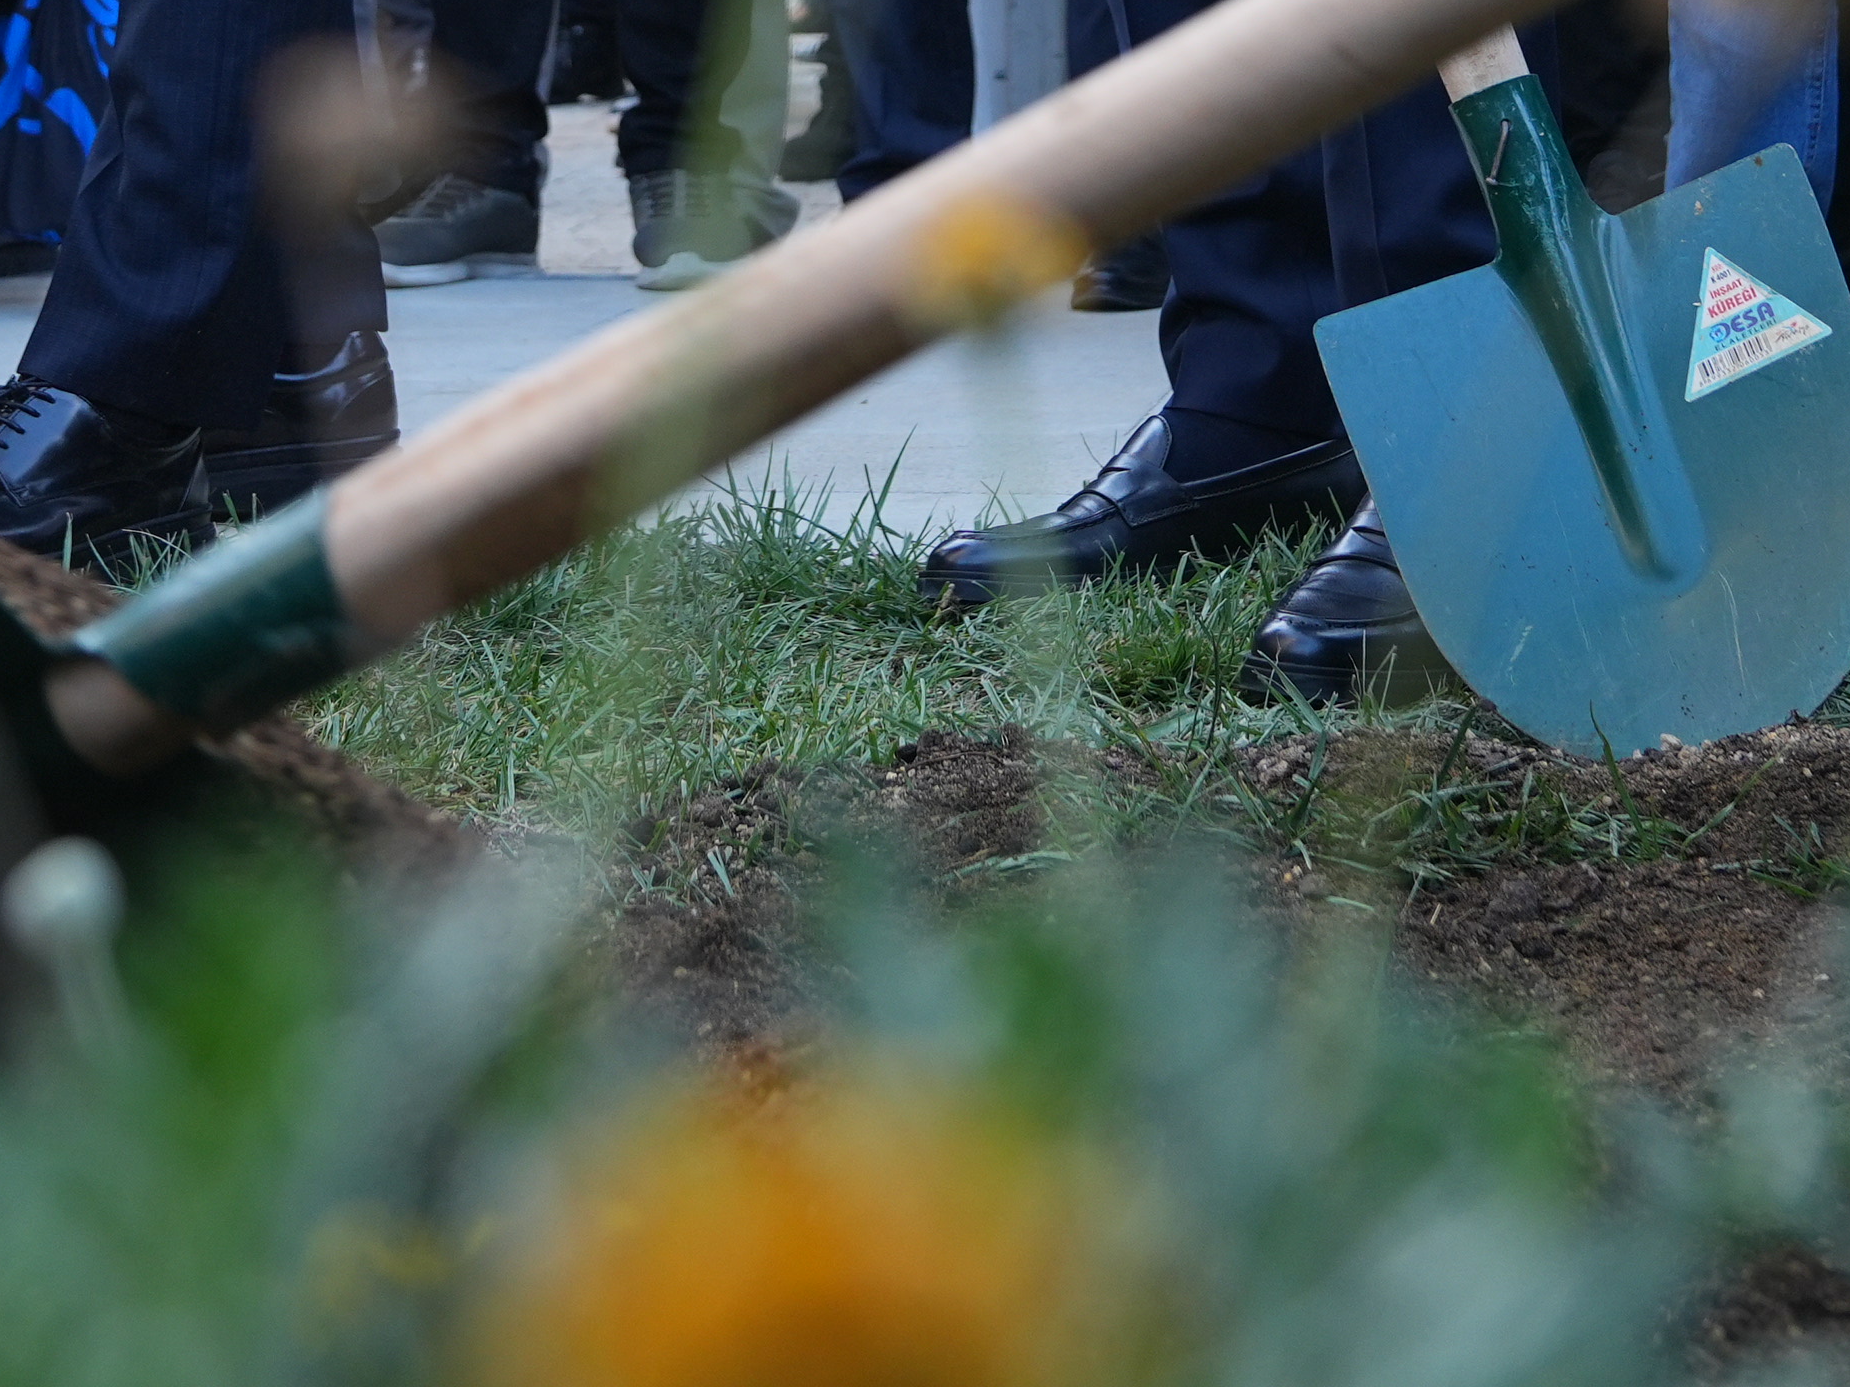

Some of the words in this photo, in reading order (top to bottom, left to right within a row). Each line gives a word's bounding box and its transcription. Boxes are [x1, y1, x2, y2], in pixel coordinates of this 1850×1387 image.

[1706, 285, 1758, 319] KÜREĞİ
[1709, 278, 1744, 301] İNŞAAT
[1708, 301, 1776, 344] DESA
[1714, 341, 1727, 352] EL
